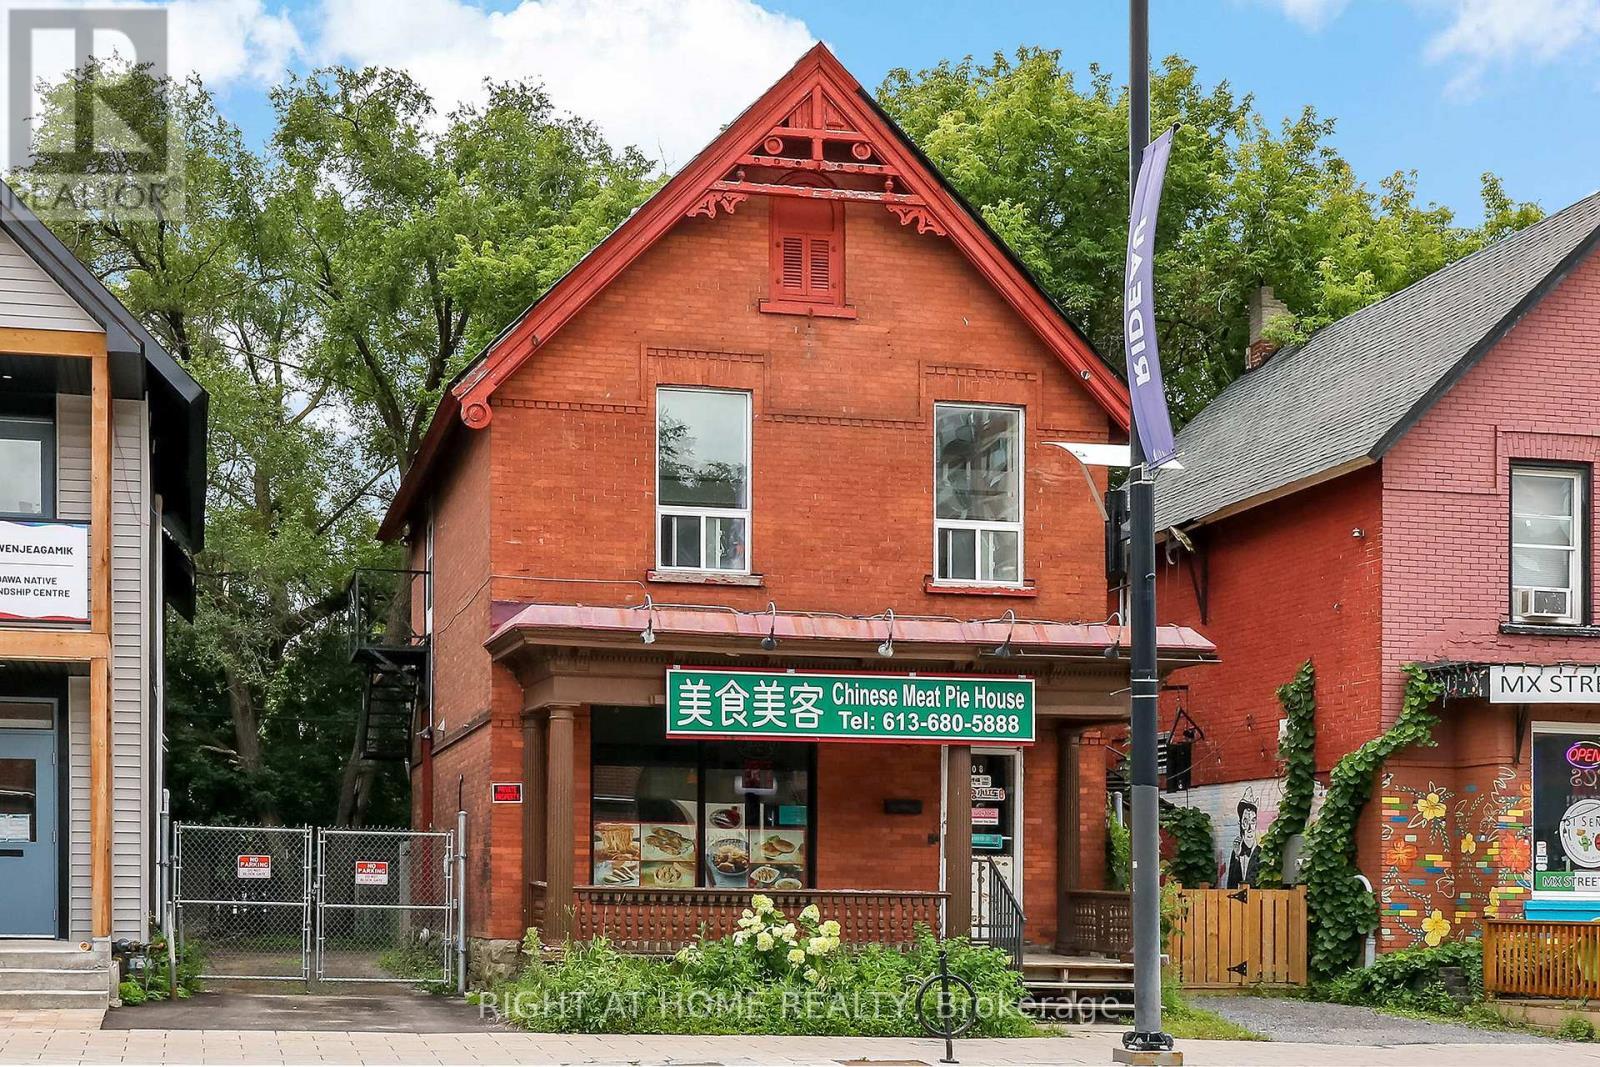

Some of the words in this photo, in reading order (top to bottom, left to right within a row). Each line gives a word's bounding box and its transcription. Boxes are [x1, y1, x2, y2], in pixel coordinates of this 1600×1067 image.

[24, 576, 57, 585] NATIVE
[33, 588, 70, 598] CENTRE
[1501, 675, 1542, 693] MX
[832, 681, 898, 706] Chinese
[902, 684, 940, 708] Meat
[945, 685, 970, 708] Pie
[974, 686, 1025, 710] House
[677, 678, 824, 730] 美食美客
[838, 711, 875, 730] Tel:
[882, 712, 1020, 733] 613-680-5888
[1569, 748, 1600, 761] OPEN
[1542, 876, 1562, 888] MX
